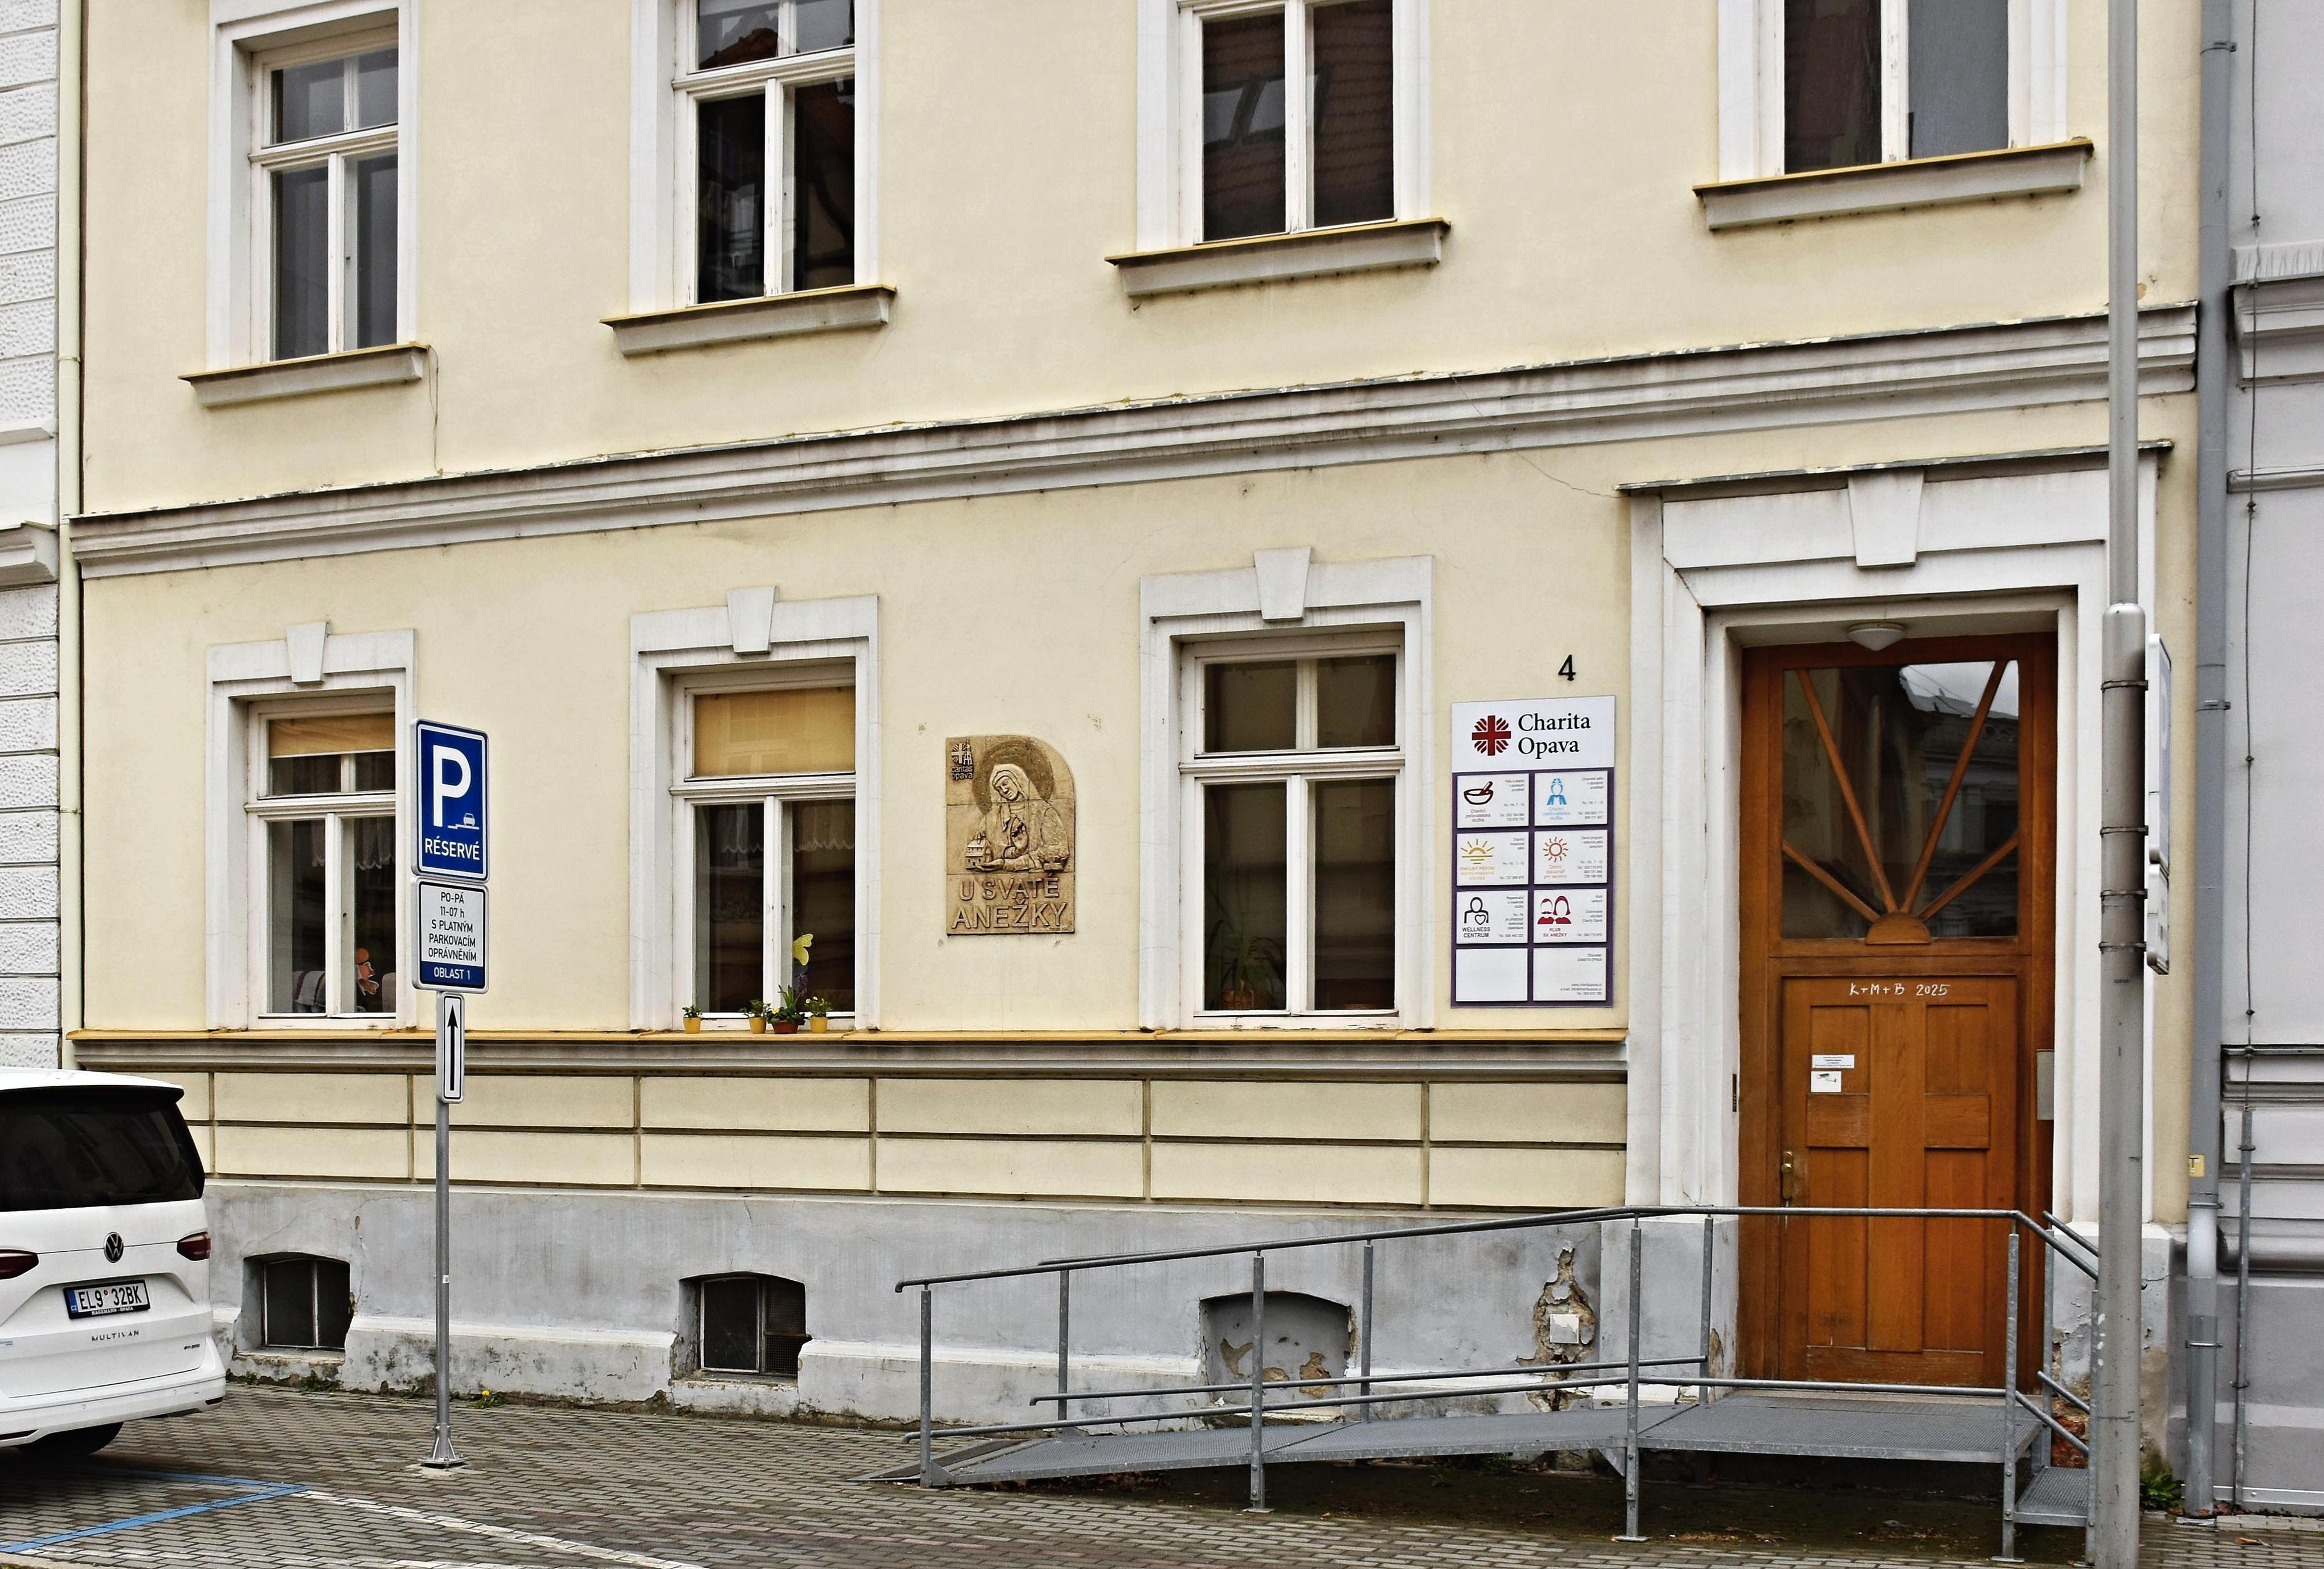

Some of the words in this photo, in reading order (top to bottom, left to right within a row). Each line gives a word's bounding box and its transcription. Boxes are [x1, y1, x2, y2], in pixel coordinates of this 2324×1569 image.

[1558, 654, 1576, 681] 4
[1518, 712, 1591, 732] Charita
[1518, 737, 1580, 759] Opava
[951, 773, 973, 781] opava
[433, 744, 471, 827] P
[425, 836, 480, 860] RÉSERVÉ
[960, 879, 974, 902] U
[982, 873, 1060, 900] SVATÉ
[441, 892, 464, 904] PO-PÁ
[440, 906, 458, 917] 11-07
[460, 908, 465, 918] h
[951, 899, 1067, 929] ANEŽKY
[432, 919, 436, 929] S
[439, 920, 473, 933] PLATNÝM
[429, 933, 476, 947] PARKOVACÍM
[428, 947, 477, 961] OPRÁVNĚNÍM
[433, 967, 464, 979] OBLAST
[467, 970, 471, 980] 1
[1916, 983, 1951, 996] 2025
[78, 1290, 103, 1310] EL9
[111, 1286, 142, 1306] 32BK
[91, 1330, 139, 1342] MULTIVAN
